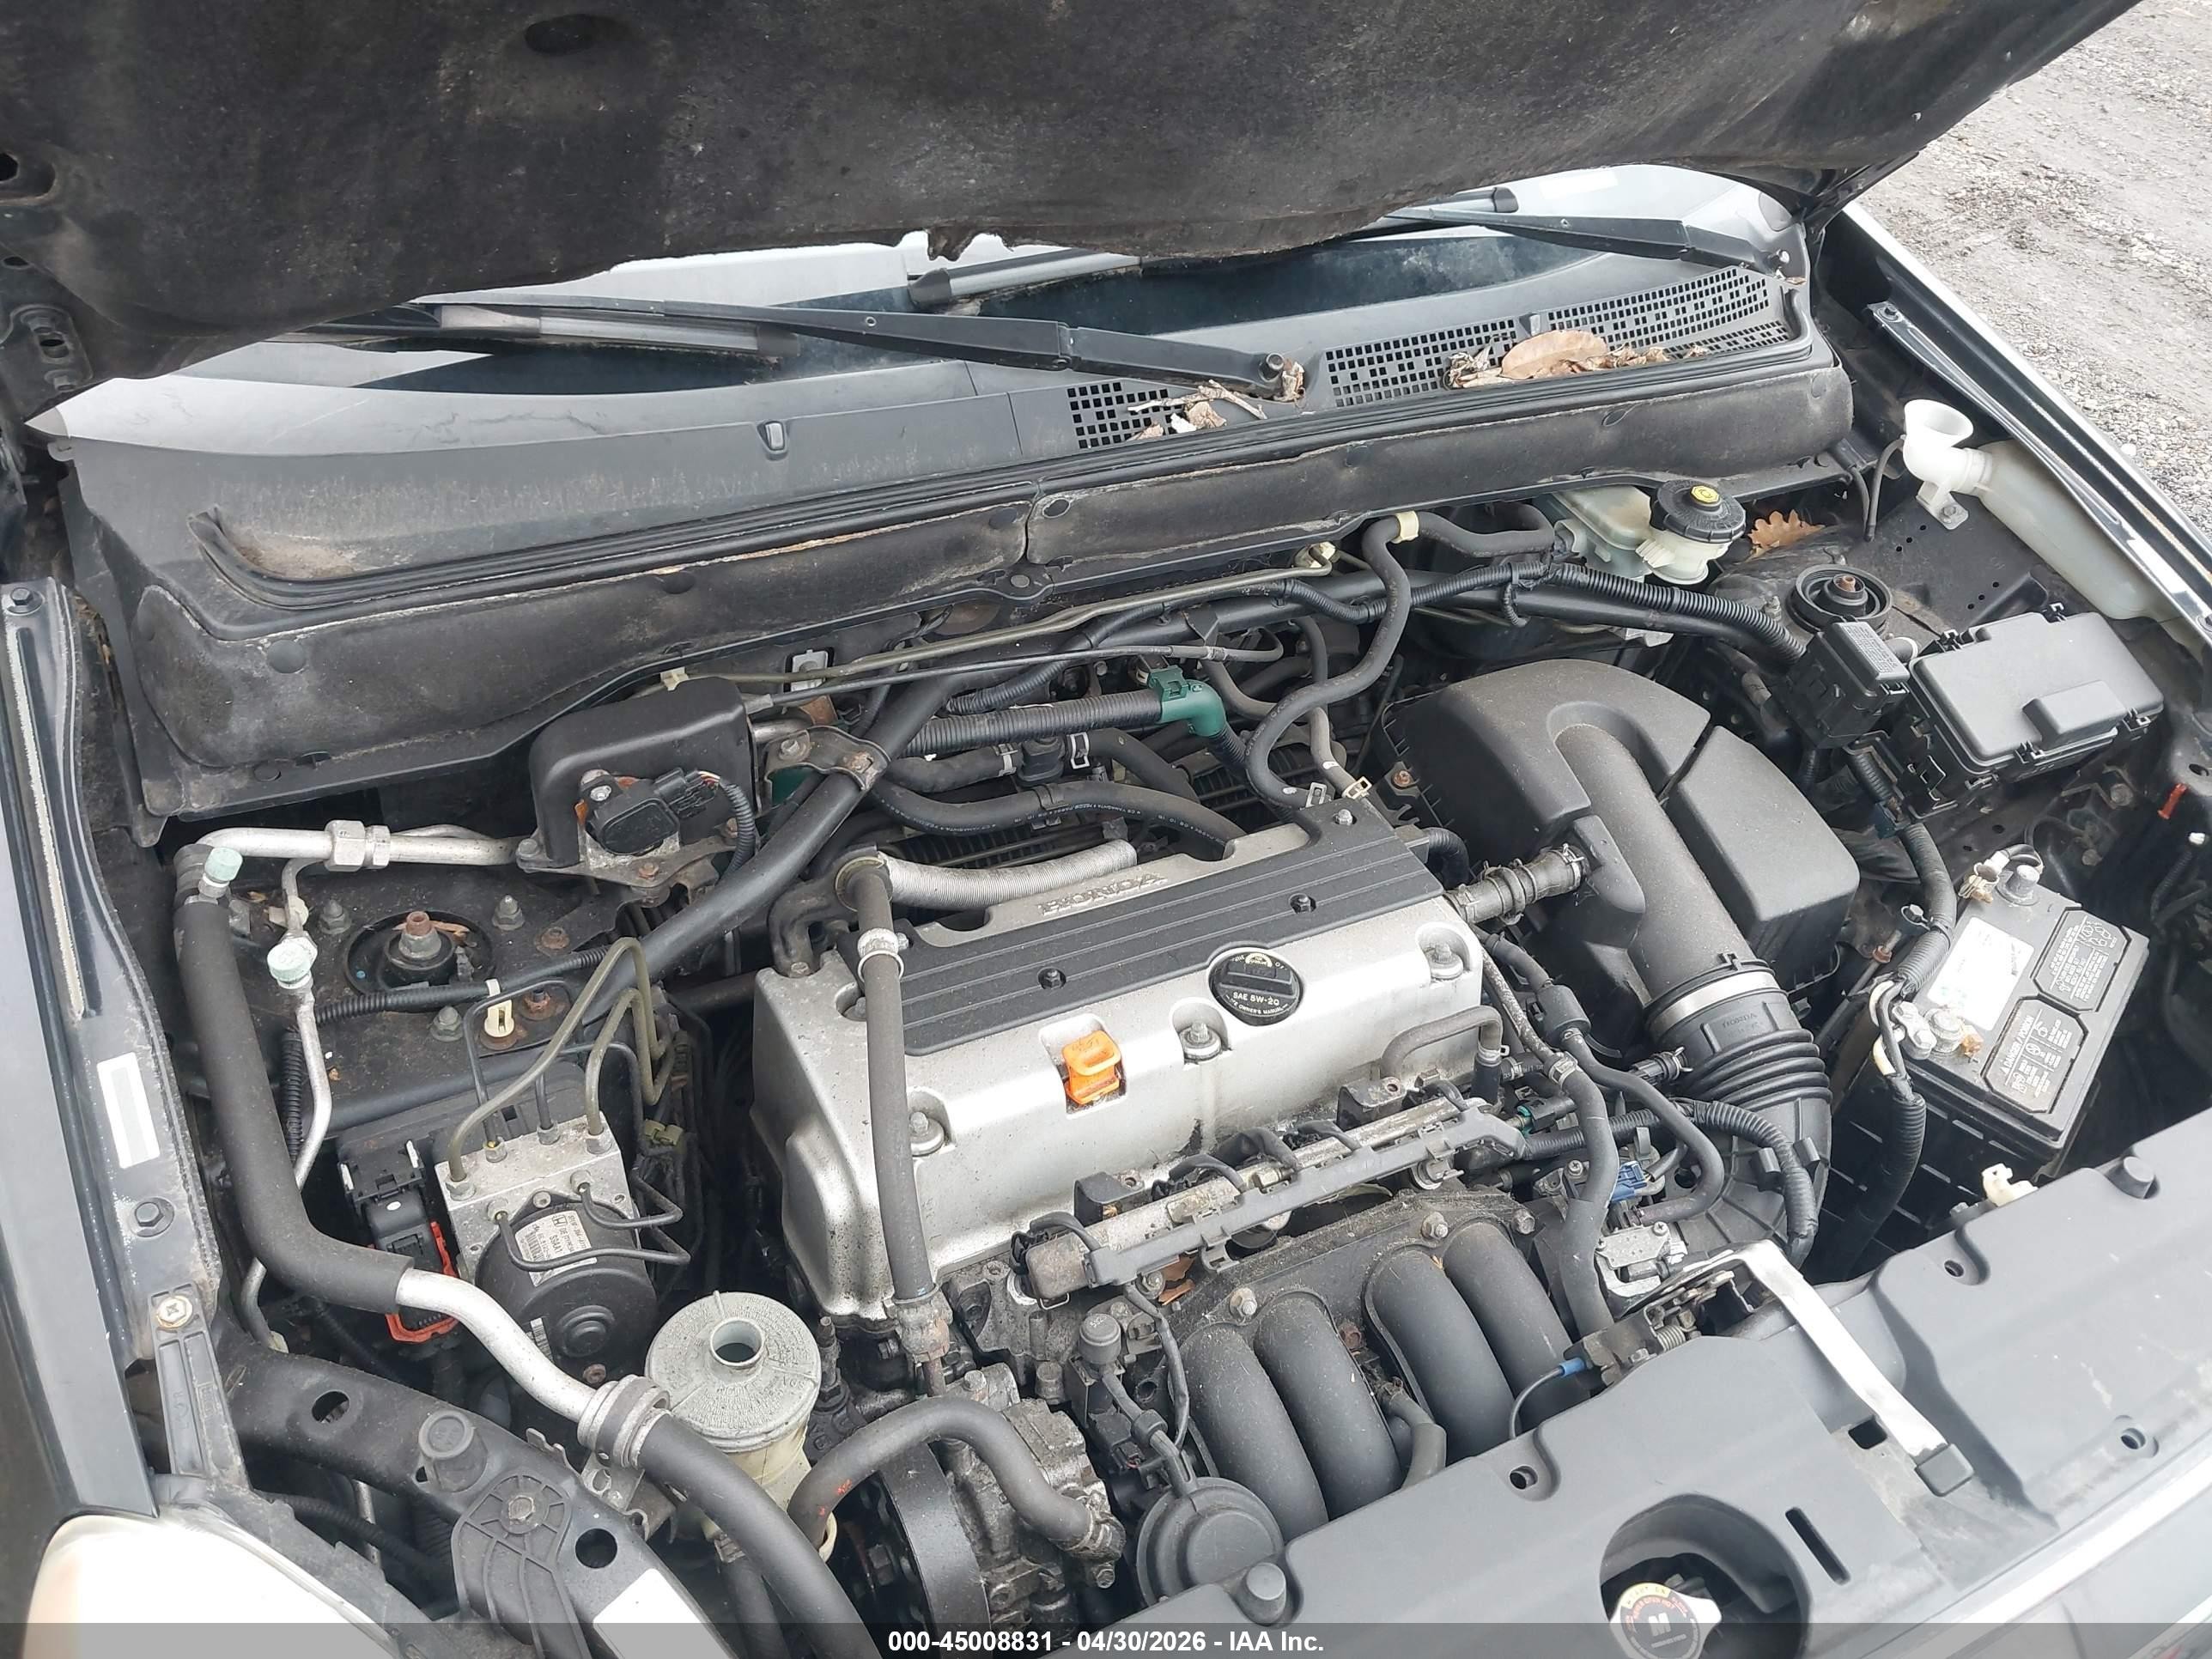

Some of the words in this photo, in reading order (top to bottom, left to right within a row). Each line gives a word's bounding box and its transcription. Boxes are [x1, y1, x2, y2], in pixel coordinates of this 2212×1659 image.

[1037, 872, 1169, 915] HONDA
[1233, 992, 1248, 1001] SAE
[1250, 994, 1279, 1006] 5W-20
[1238, 1004, 1261, 1015] OWNER'S
